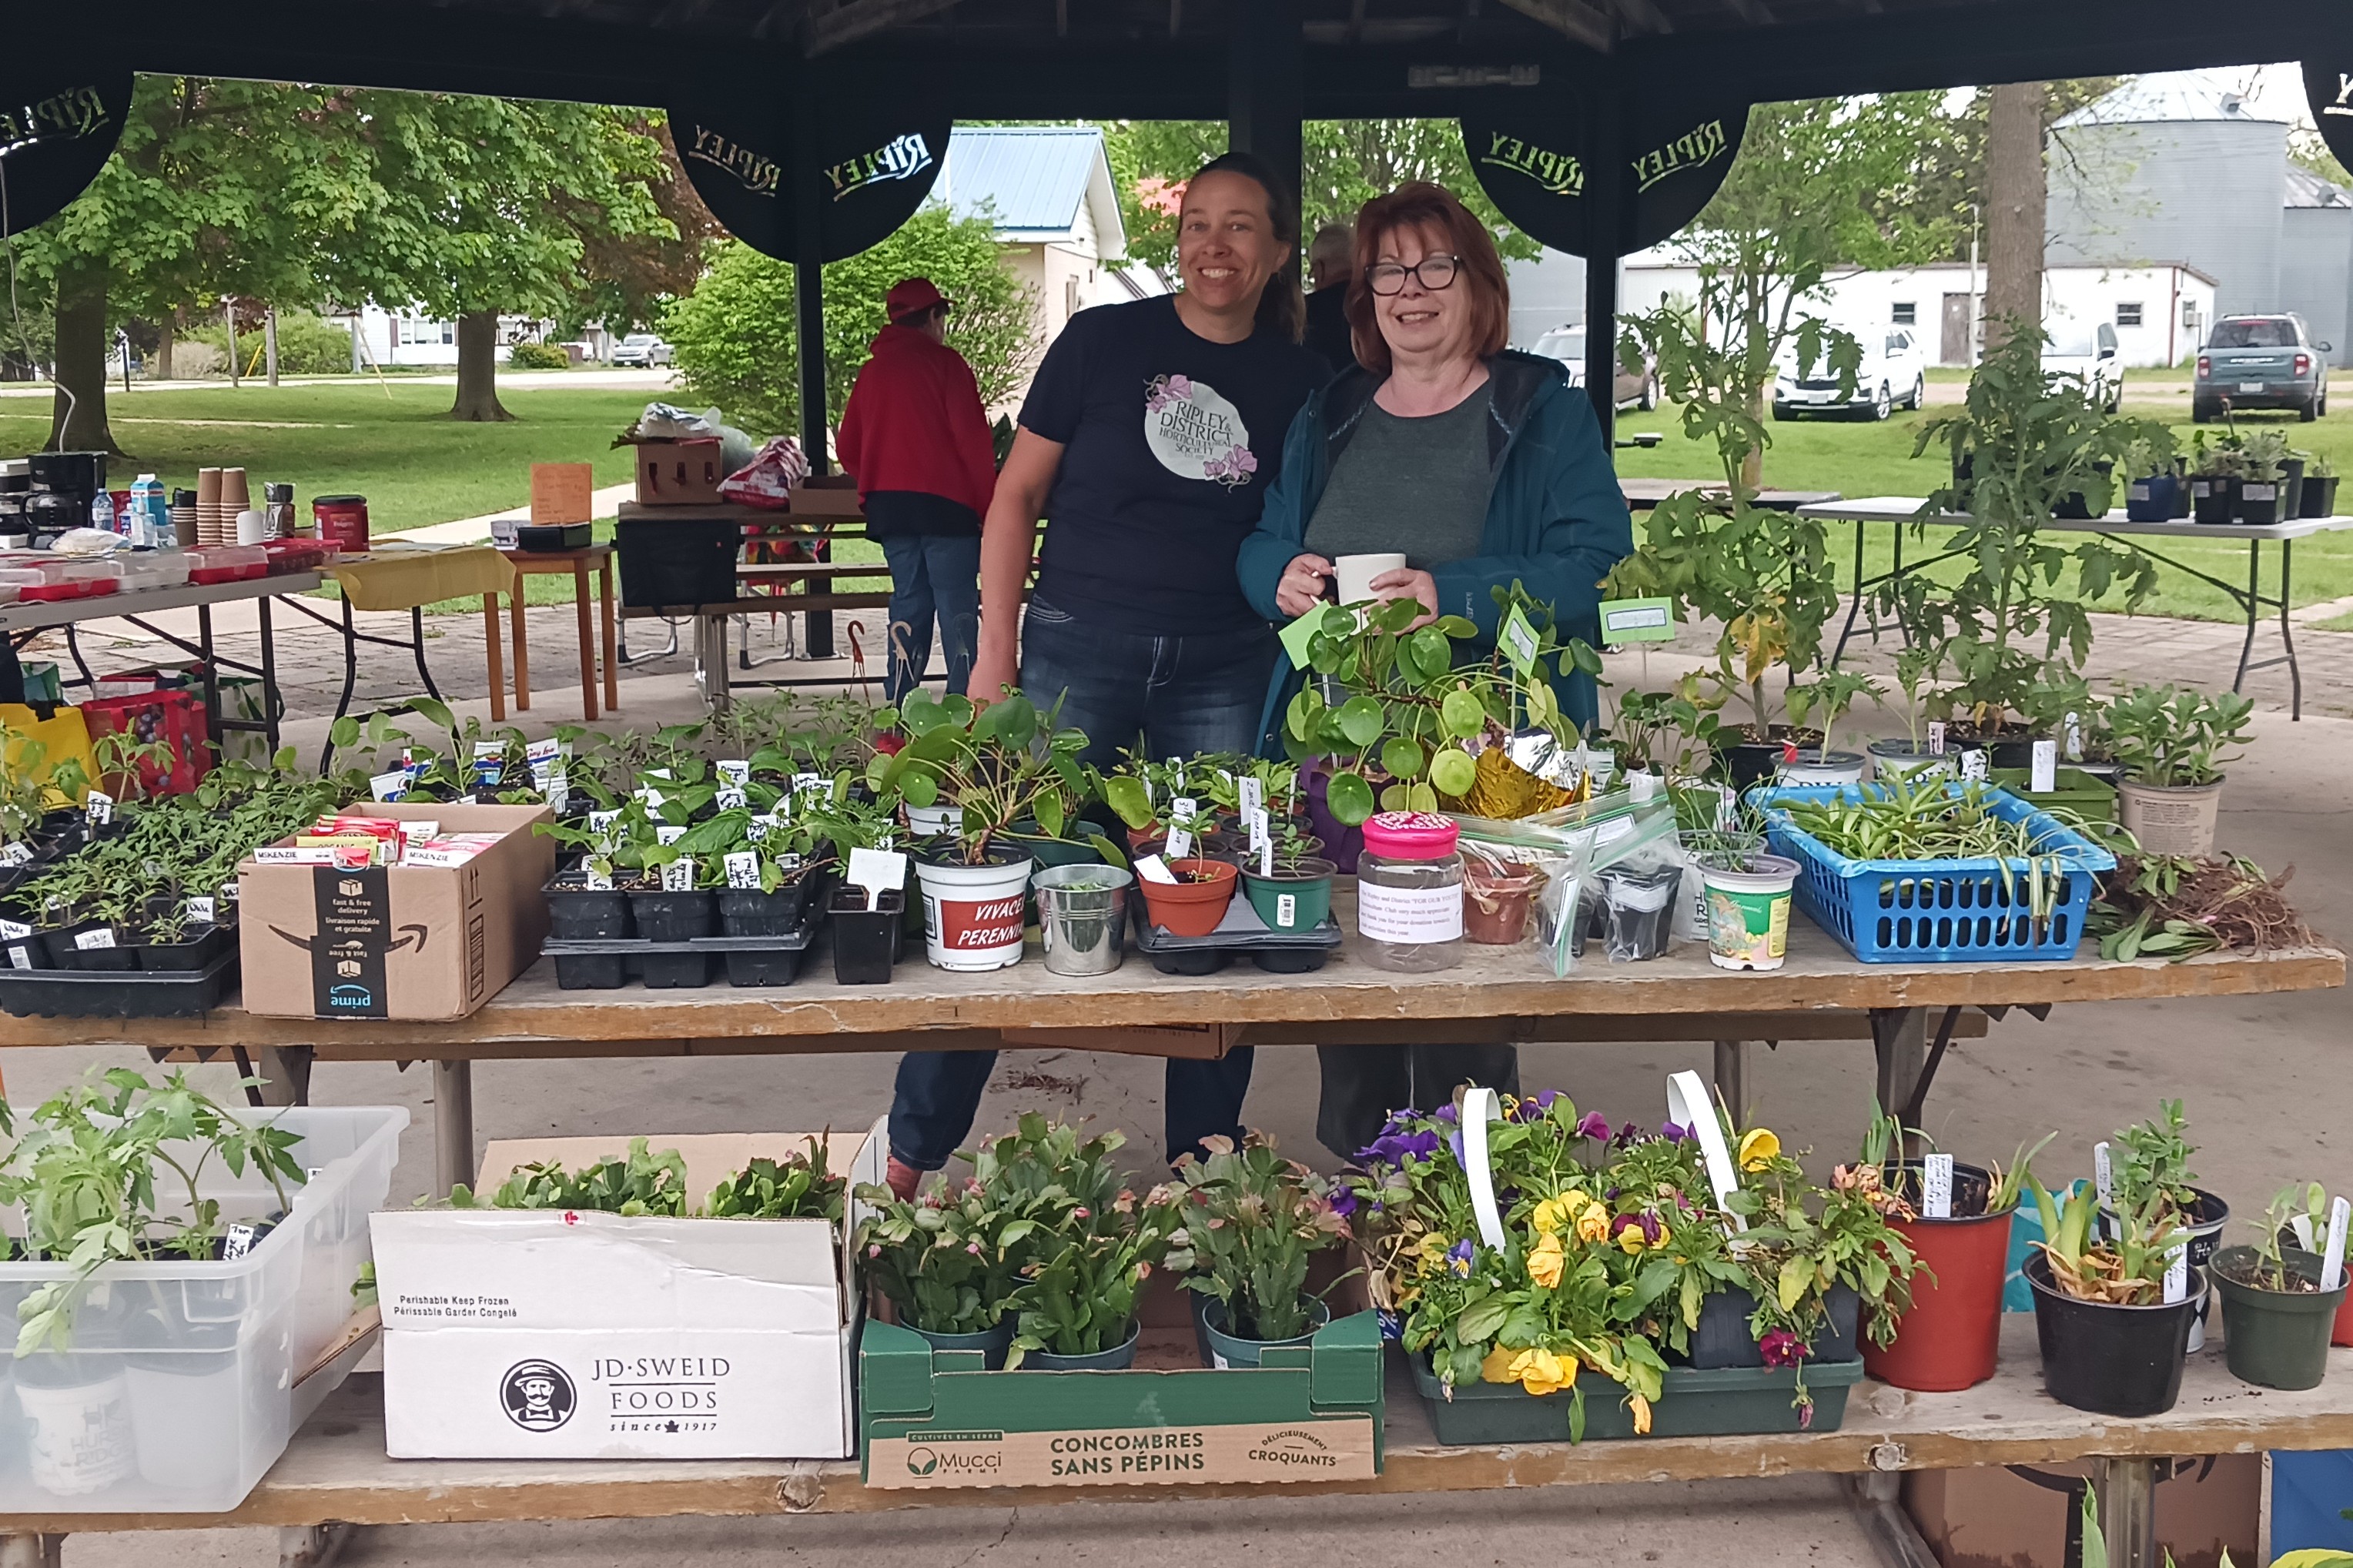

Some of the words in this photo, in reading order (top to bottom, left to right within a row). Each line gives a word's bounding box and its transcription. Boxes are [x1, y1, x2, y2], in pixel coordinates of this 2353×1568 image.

[1176, 401, 1227, 430] RIPLEY
[1160, 412, 1231, 443] DISTRICT
[337, 907, 368, 916] delivery
[325, 916, 356, 924] livraison
[356, 917, 380, 926] rapide
[330, 994, 371, 1009] prime
[400, 1295, 449, 1305] Perishable
[451, 1296, 475, 1306] Keep
[478, 1296, 509, 1306] Frozen
[393, 1306, 442, 1316] Périssable
[445, 1307, 477, 1317] Garder
[480, 1308, 517, 1319] Congelé
[611, 1391, 718, 1409] FOODS
[610, 1421, 661, 1432] since
[684, 1422, 717, 1432] 1917
[1050, 1433, 1203, 1454] CONCOMBRES
[1261, 1429, 1328, 1451] DÉLICIEUSEMENT
[939, 1451, 1002, 1469] Mucci
[1050, 1456, 1113, 1476] SANS
[1120, 1451, 1205, 1473] PÉPINS
[1248, 1449, 1337, 1467] CROQUANTS
